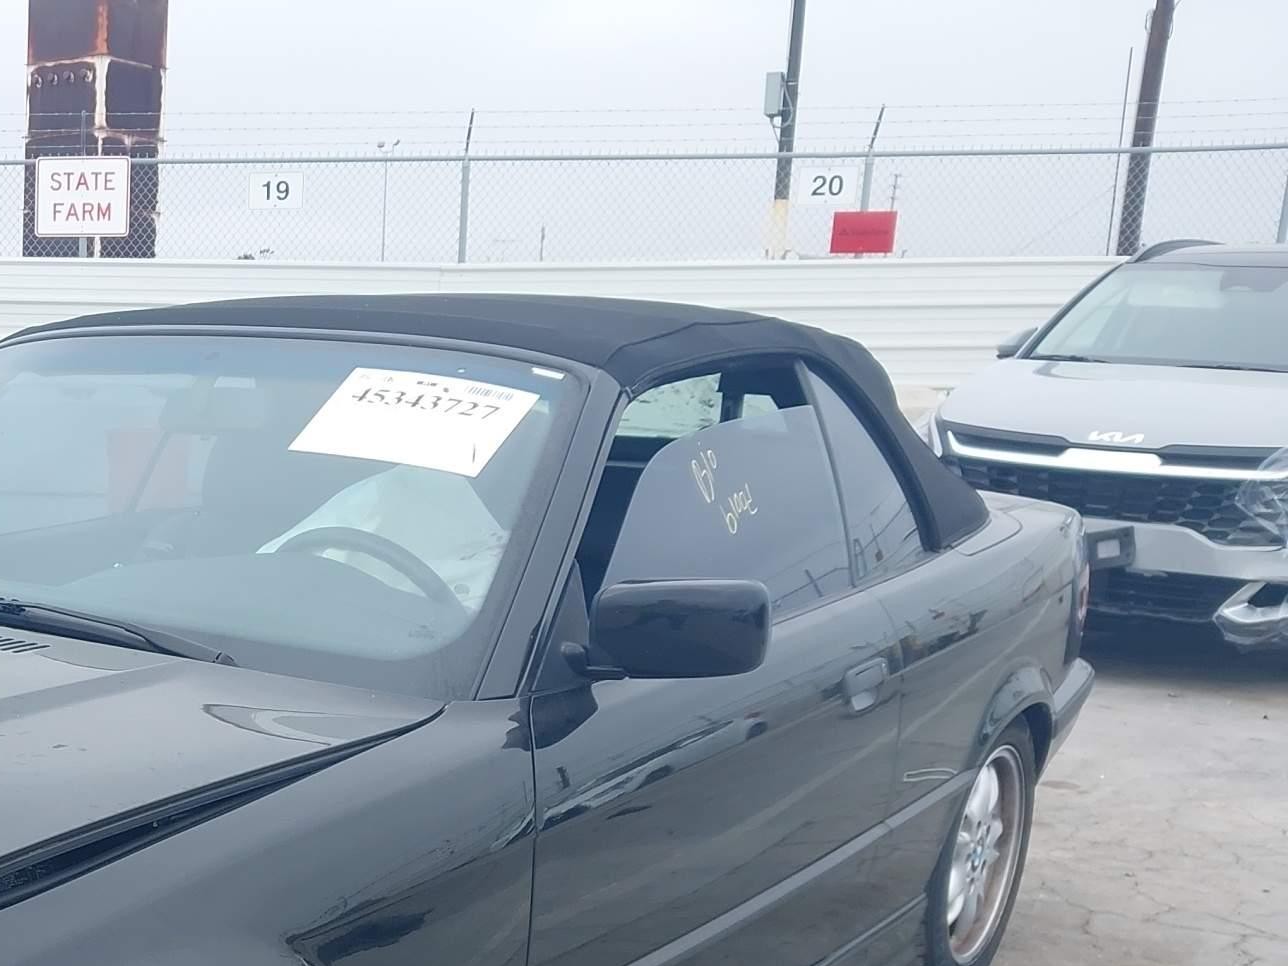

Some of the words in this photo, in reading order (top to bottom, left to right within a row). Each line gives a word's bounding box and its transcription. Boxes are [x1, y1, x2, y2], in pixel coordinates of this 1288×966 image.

[50, 171, 116, 192] STATE
[261, 180, 290, 201] 19
[810, 175, 844, 197] 20
[52, 202, 113, 223] FARM
[351, 387, 501, 419] 45343727
[1088, 430, 1145, 444] KIA
